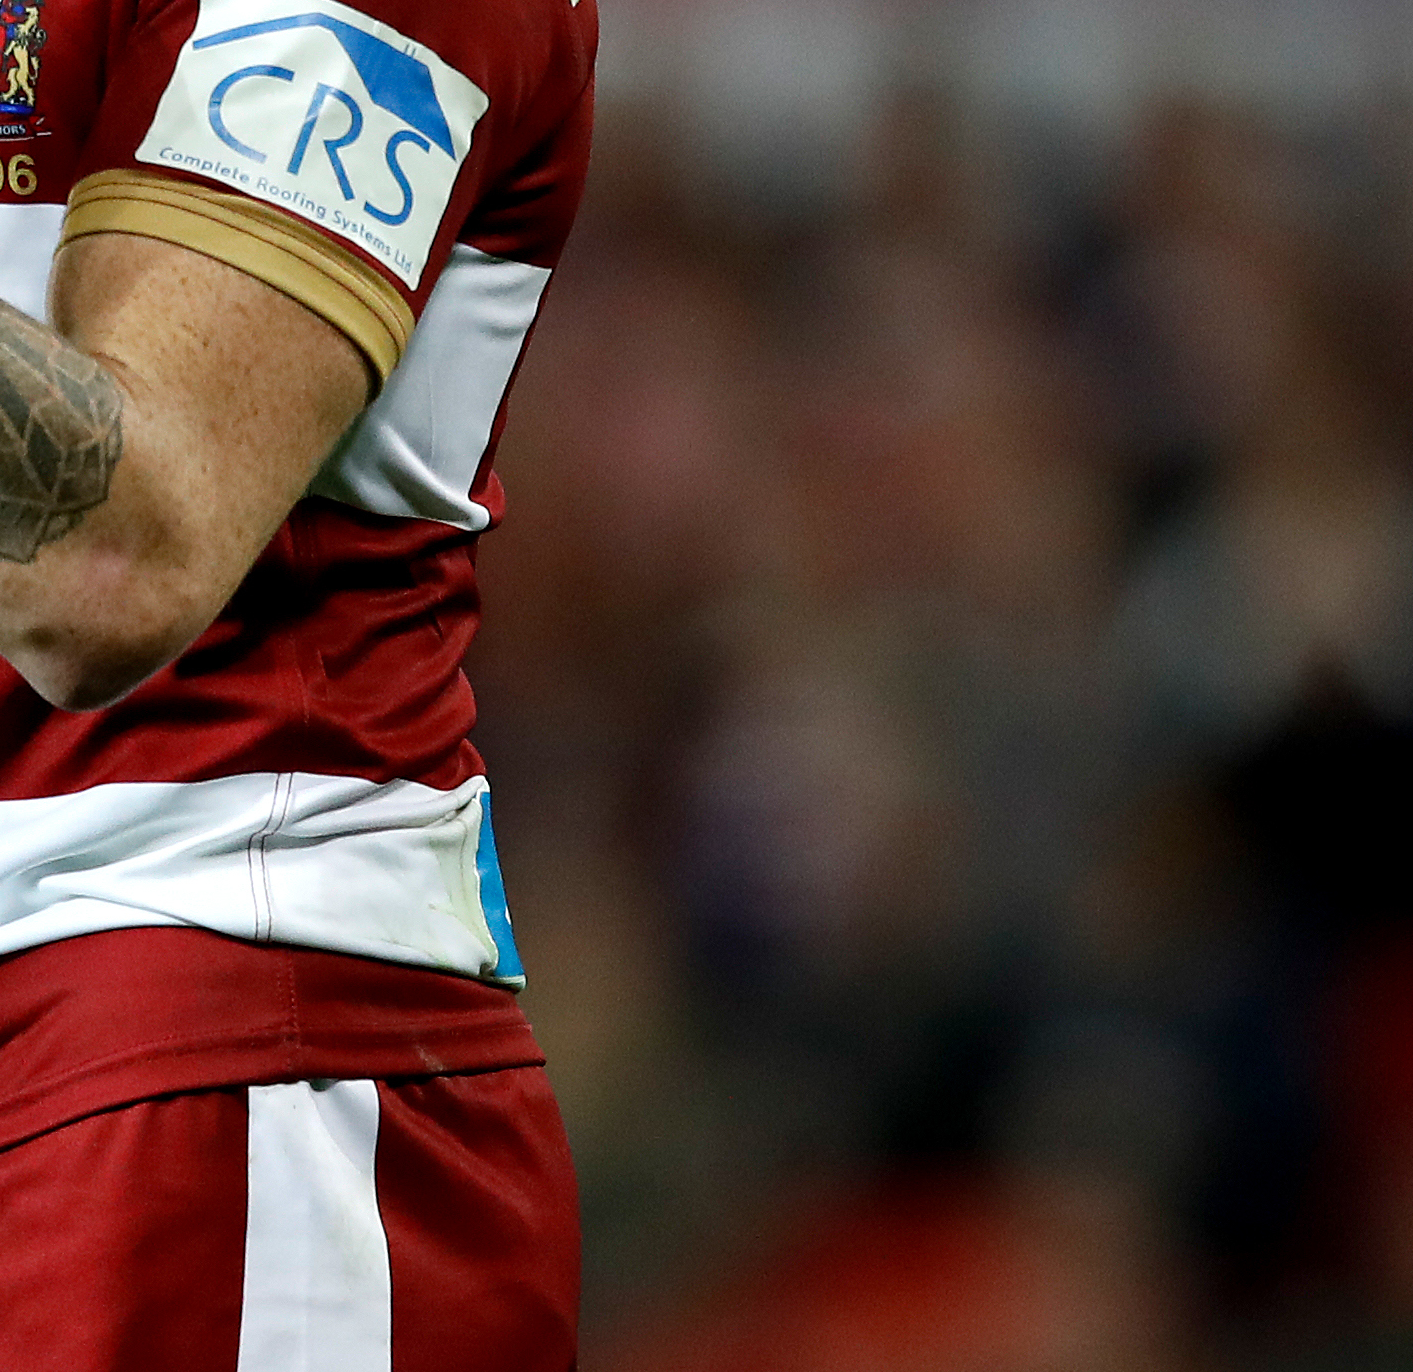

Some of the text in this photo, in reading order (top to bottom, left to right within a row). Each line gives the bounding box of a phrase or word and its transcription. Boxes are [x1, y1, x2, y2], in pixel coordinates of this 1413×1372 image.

[159, 147, 413, 275] Complete Roofing Systems Ltd
[208, 64, 431, 227] CRS
